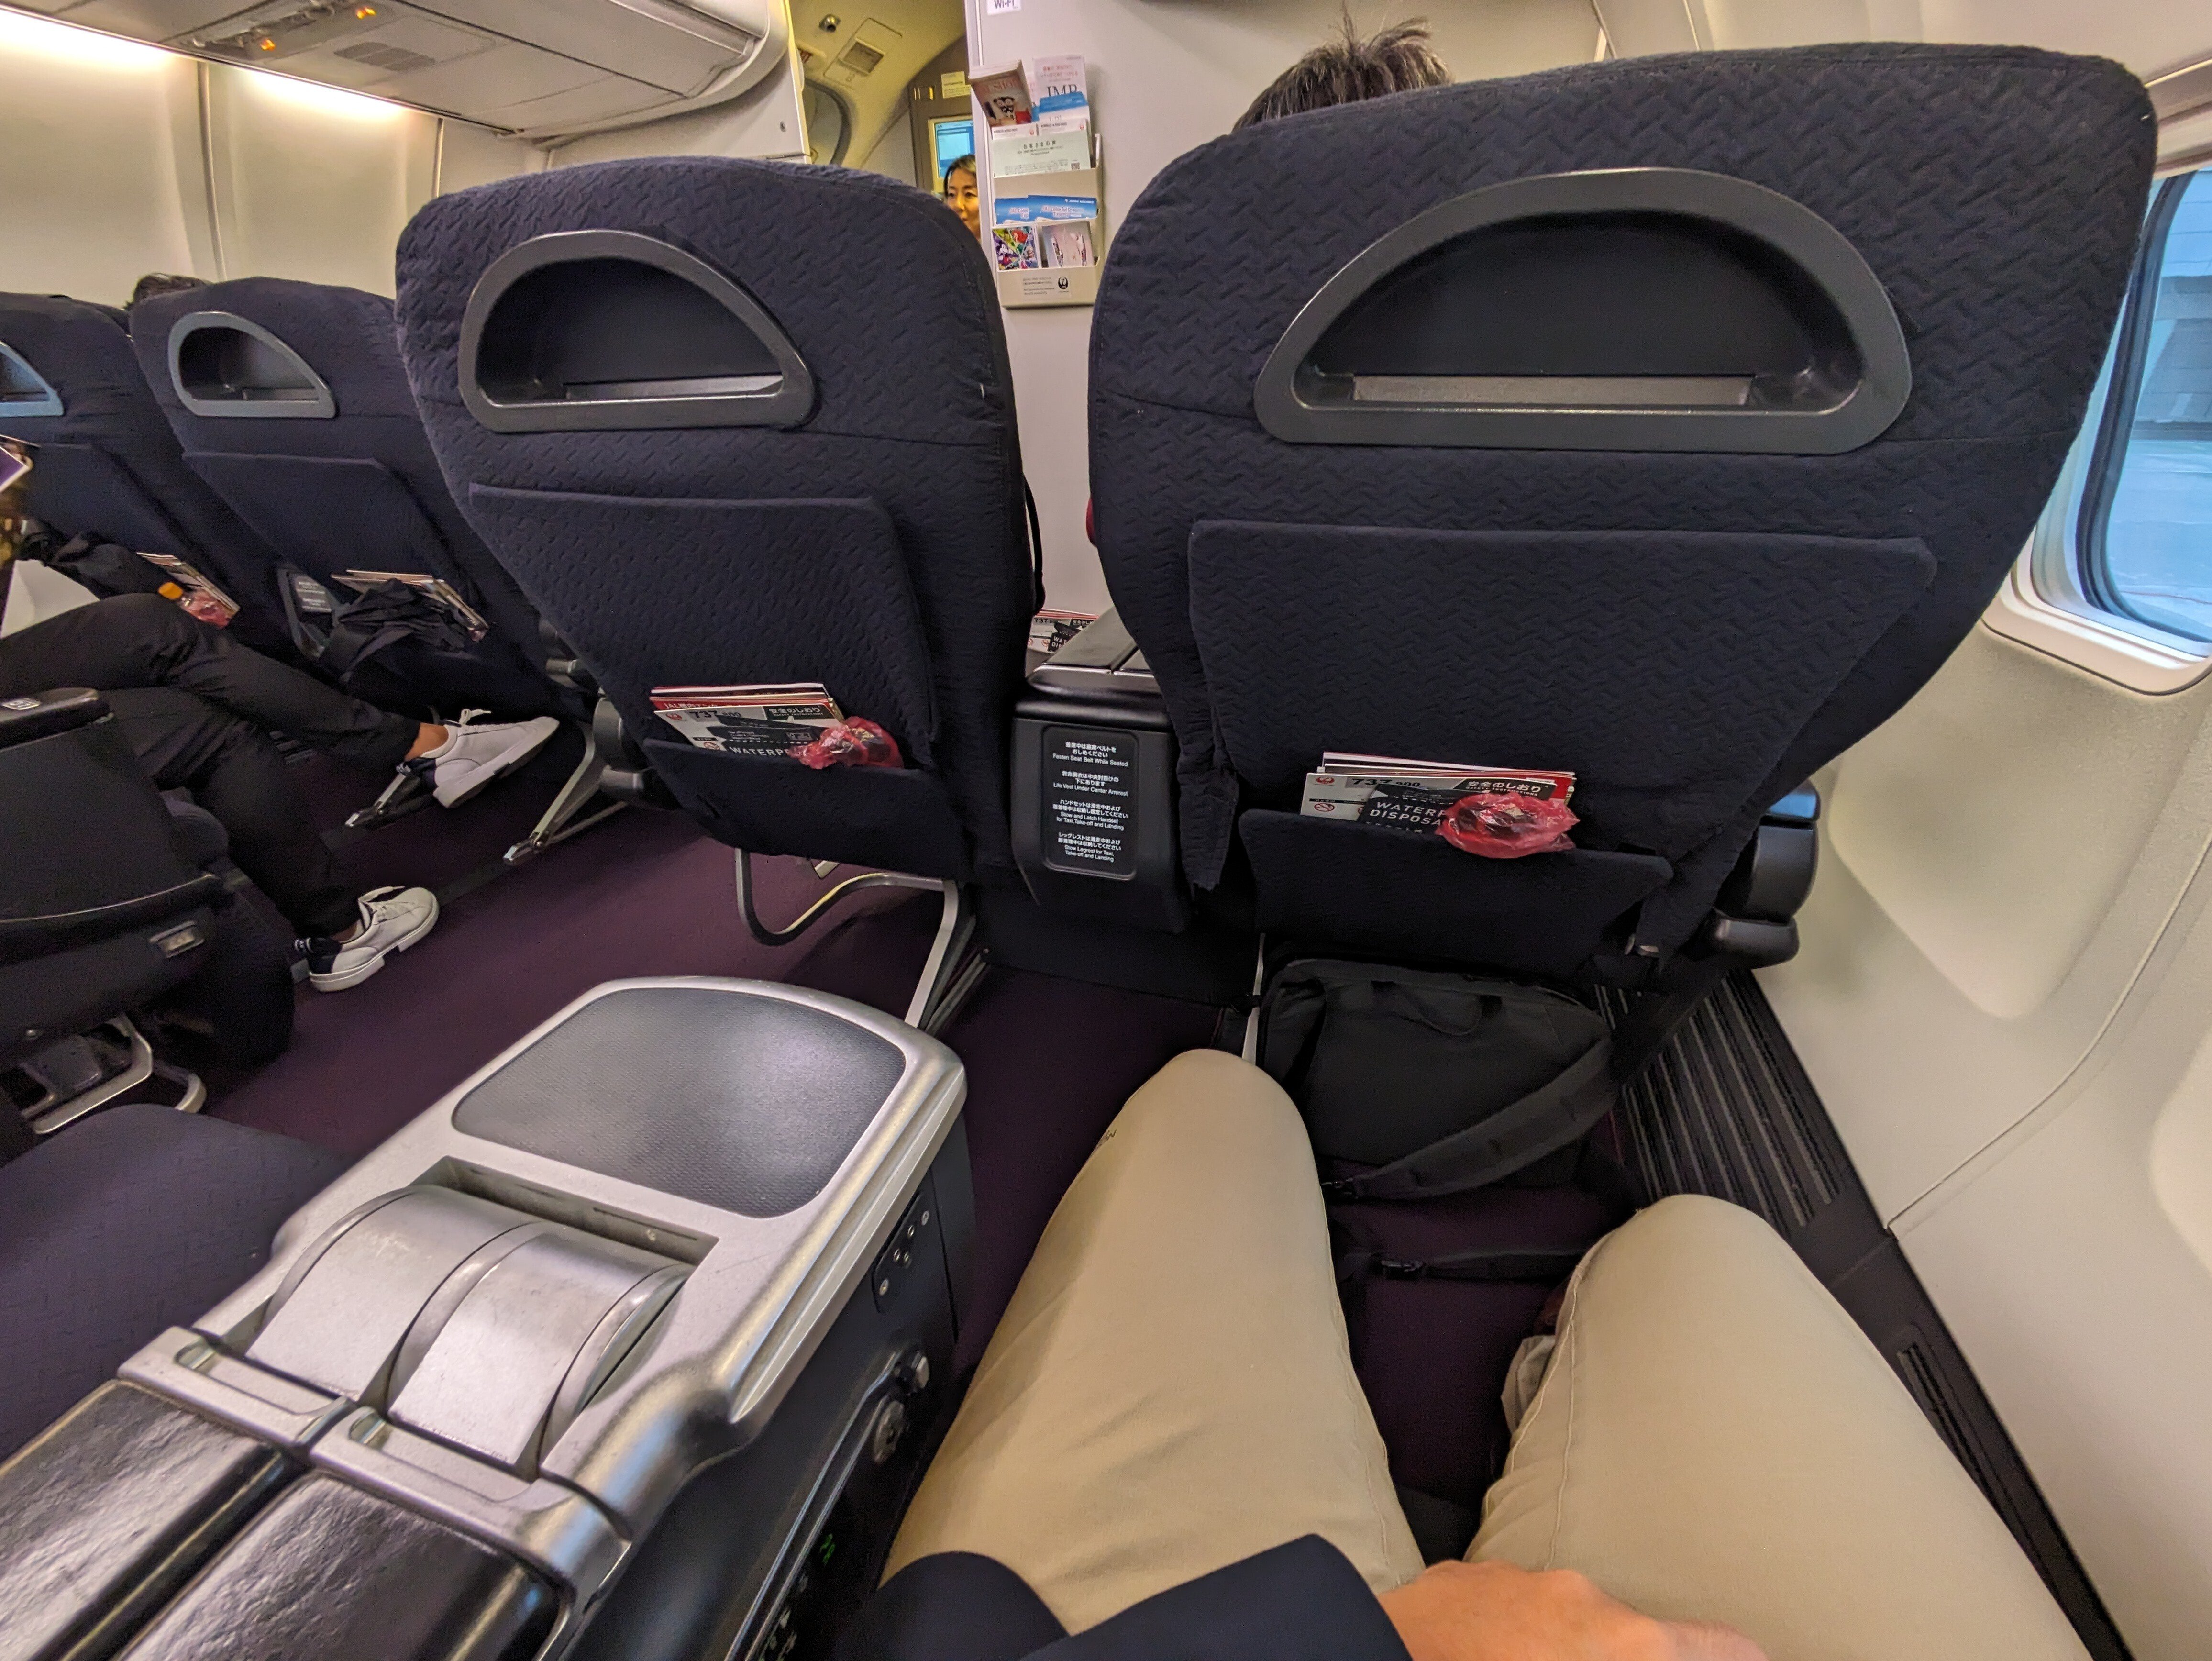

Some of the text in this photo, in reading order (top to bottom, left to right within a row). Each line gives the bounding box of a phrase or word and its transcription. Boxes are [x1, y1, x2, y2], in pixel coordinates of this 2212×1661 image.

[1468, 781, 1541, 793] 安全のしおり
[1104, 823, 1124, 831] Landing
[1095, 854, 1114, 863] Landing
